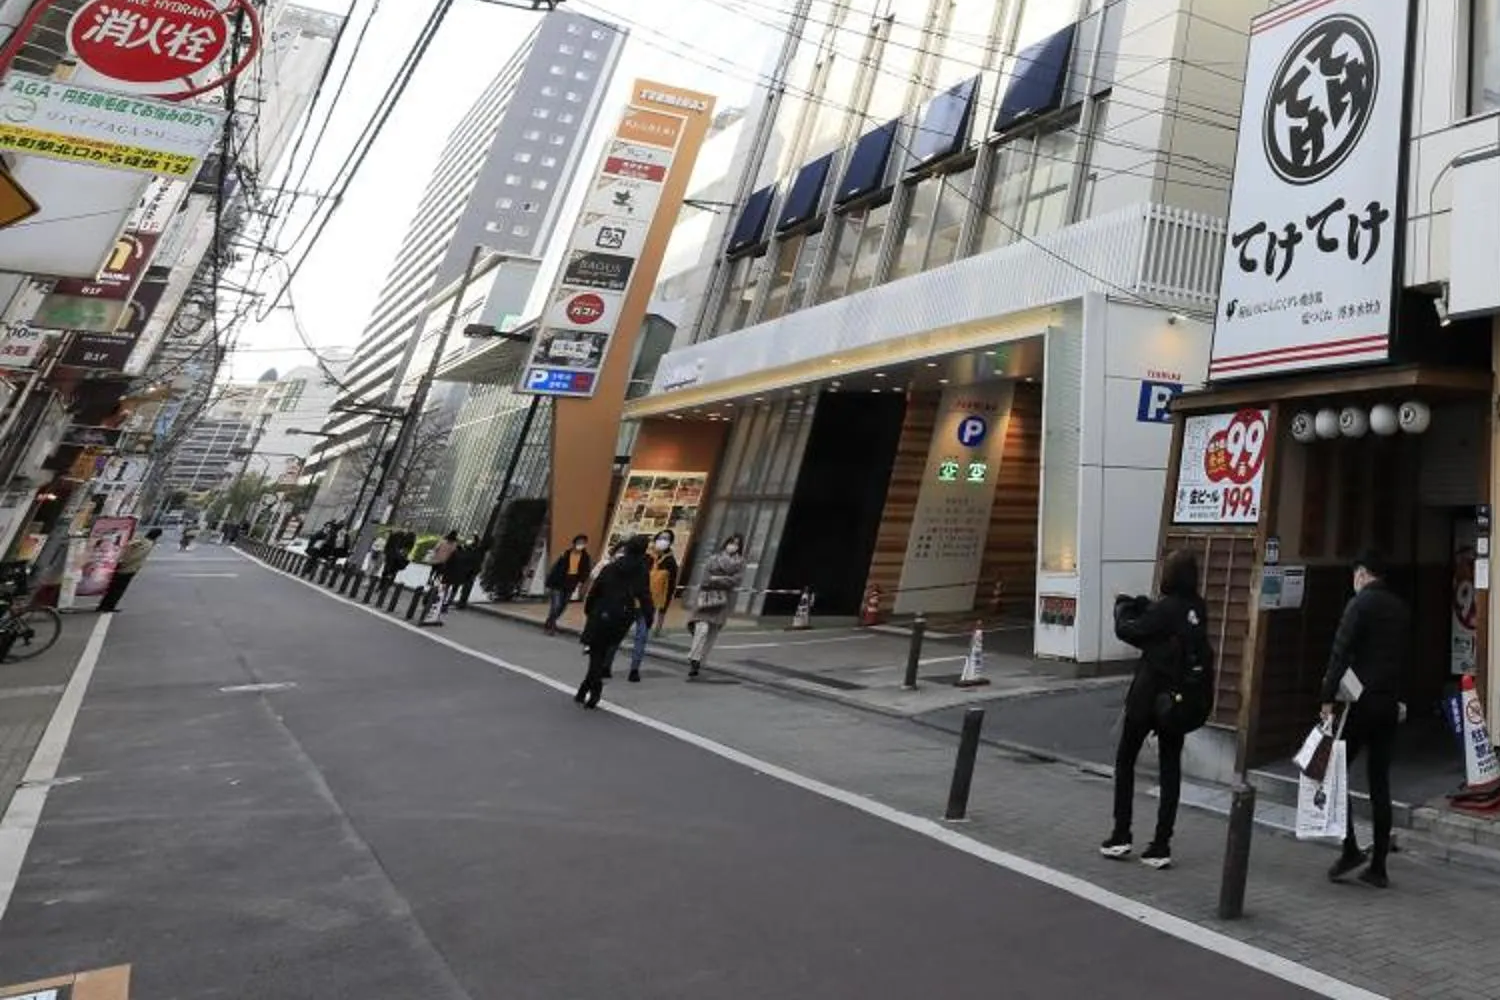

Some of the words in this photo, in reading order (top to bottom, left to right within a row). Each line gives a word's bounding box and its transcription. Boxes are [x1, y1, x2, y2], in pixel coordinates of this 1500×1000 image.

[81, 6, 217, 63] 消火栓
[1231, 197, 1389, 282] てけてけ
[1149, 384, 1174, 420] P
[963, 418, 985, 444] P
